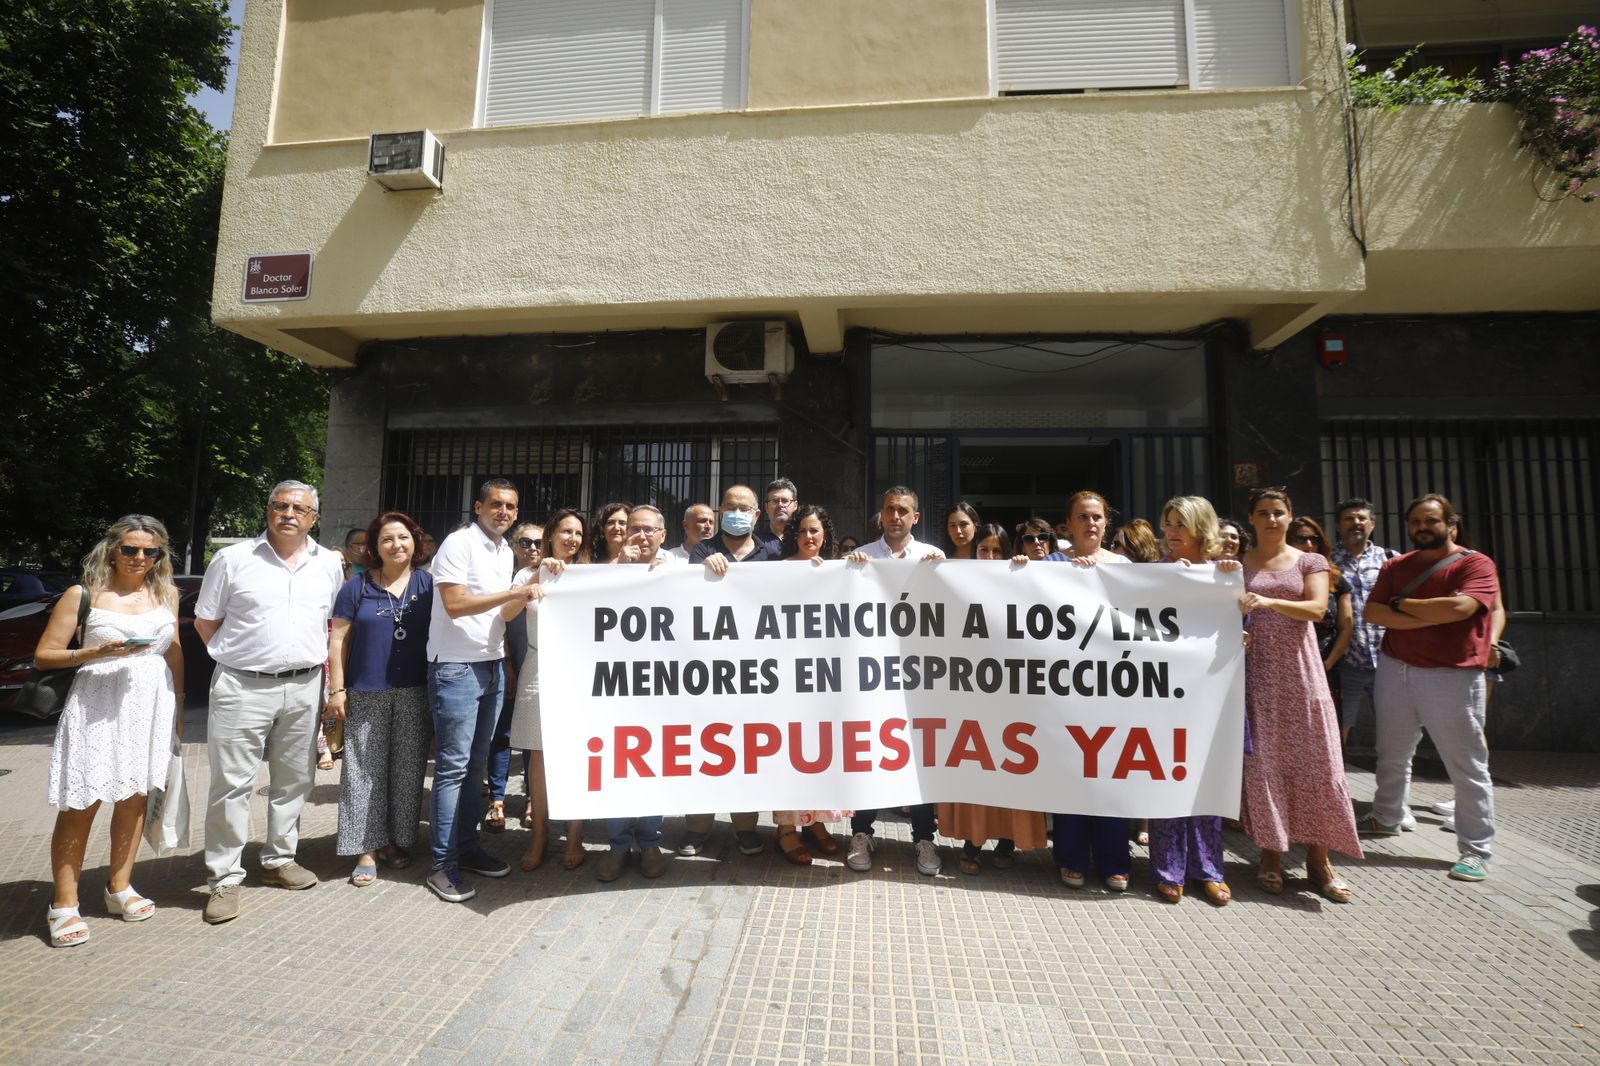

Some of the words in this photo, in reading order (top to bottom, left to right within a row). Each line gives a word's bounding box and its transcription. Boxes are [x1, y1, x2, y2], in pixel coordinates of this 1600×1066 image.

[250, 286, 278, 295] Blanco
[281, 284, 302, 293] Soler
[263, 274, 292, 282] Doctor
[594, 606, 675, 642] POR
[693, 605, 739, 641] LA
[754, 592, 945, 640] ATENCIÓN
[962, 603, 990, 639] A
[1006, 603, 1180, 651] LOS/LAS
[591, 658, 779, 697] MENORES
[795, 657, 842, 693] EN
[858, 650, 1185, 699] DESPROTECCIÓN.
[587, 718, 1039, 792] ¡RESPUESTAS
[1065, 725, 1187, 782] YA!
